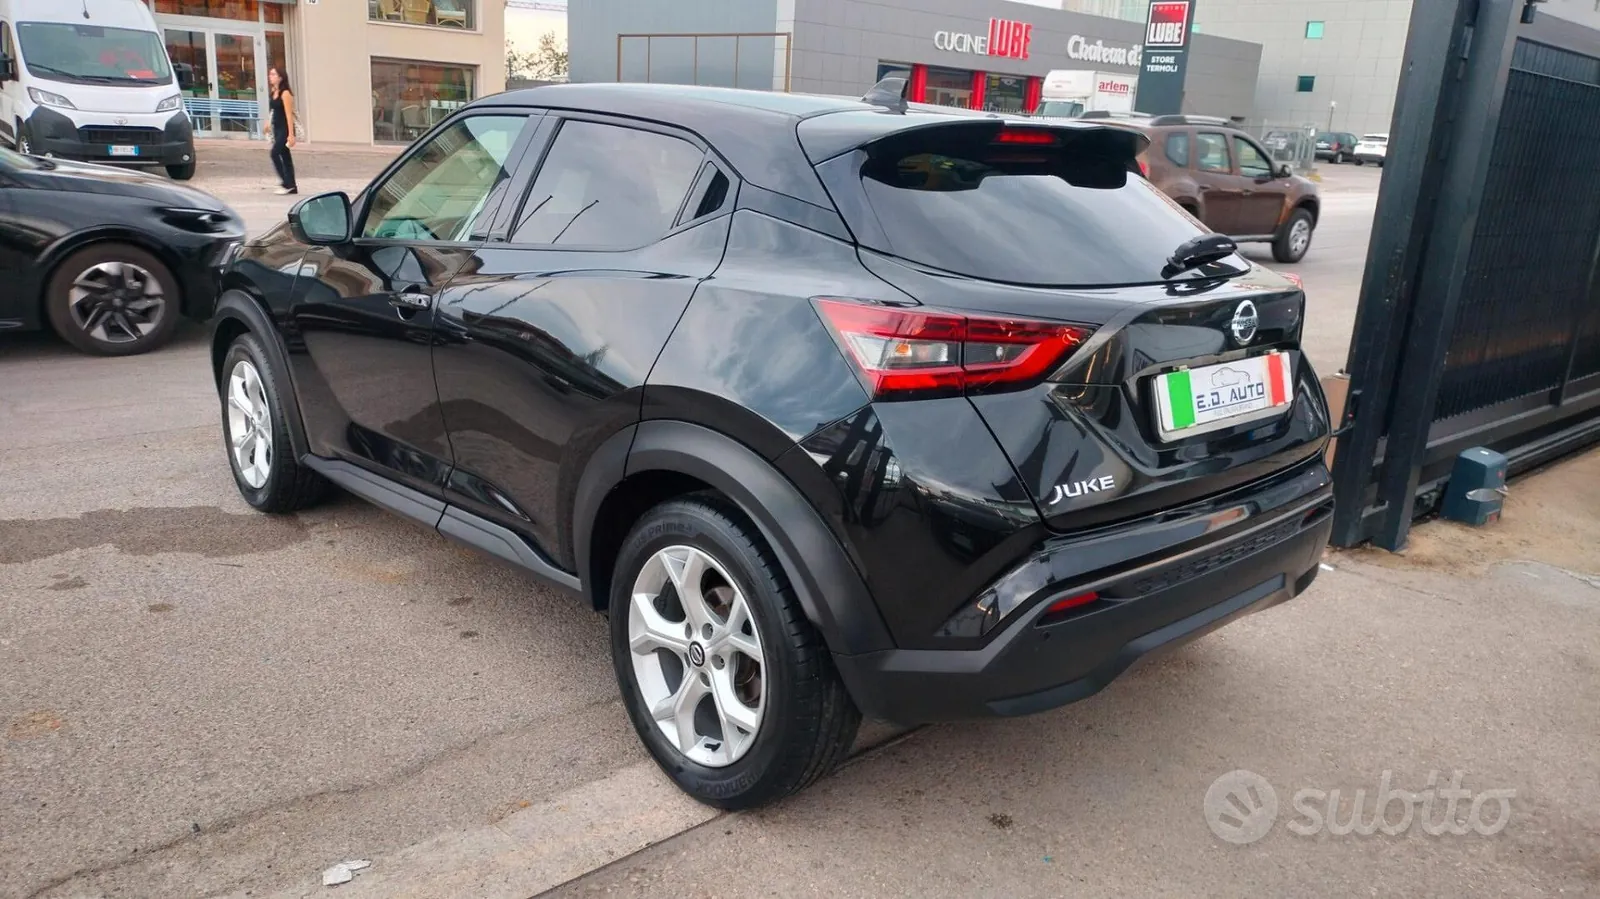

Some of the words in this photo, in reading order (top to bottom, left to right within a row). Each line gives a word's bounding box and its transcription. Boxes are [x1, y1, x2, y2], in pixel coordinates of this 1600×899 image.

[934, 30, 987, 55] CUCINE
[987, 17, 1032, 60] LUBE
[1149, 22, 1182, 42] LUBE
[1067, 35, 1127, 65] Chateau
[1146, 64, 1178, 72] TERMOLI
[1196, 391, 1225, 409] E.D.
[1230, 381, 1265, 402] AUTO
[1048, 475, 1116, 505] JUKE
